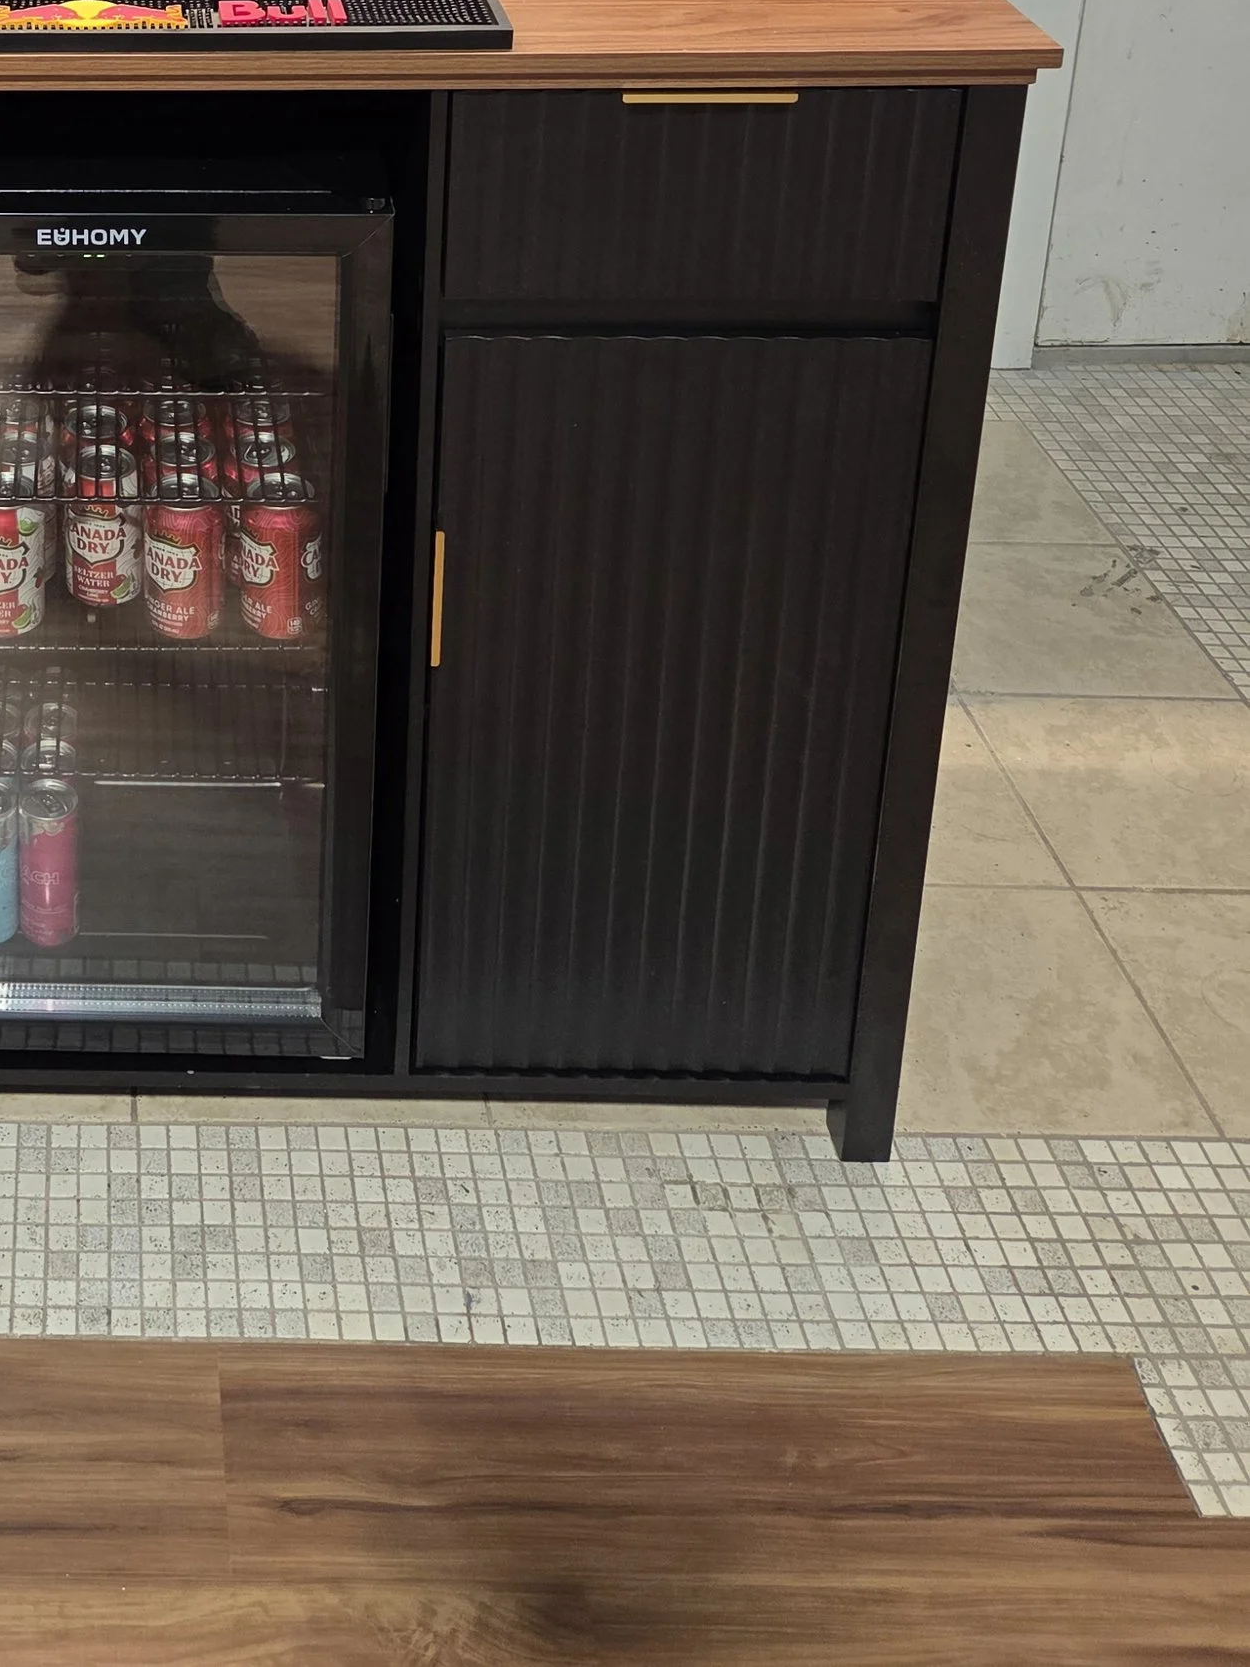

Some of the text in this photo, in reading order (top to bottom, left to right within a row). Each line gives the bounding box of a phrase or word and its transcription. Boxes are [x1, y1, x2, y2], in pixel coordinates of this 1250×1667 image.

[37, 228, 147, 246] EUHOMY
[70, 523, 127, 541] ANADA
[77, 540, 109, 554] DRY
[147, 546, 202, 571] ANADA
[74, 565, 114, 579] SELTZER
[150, 564, 182, 583] DRY
[77, 574, 110, 587] WATER
[176, 606, 195, 615] ALE
